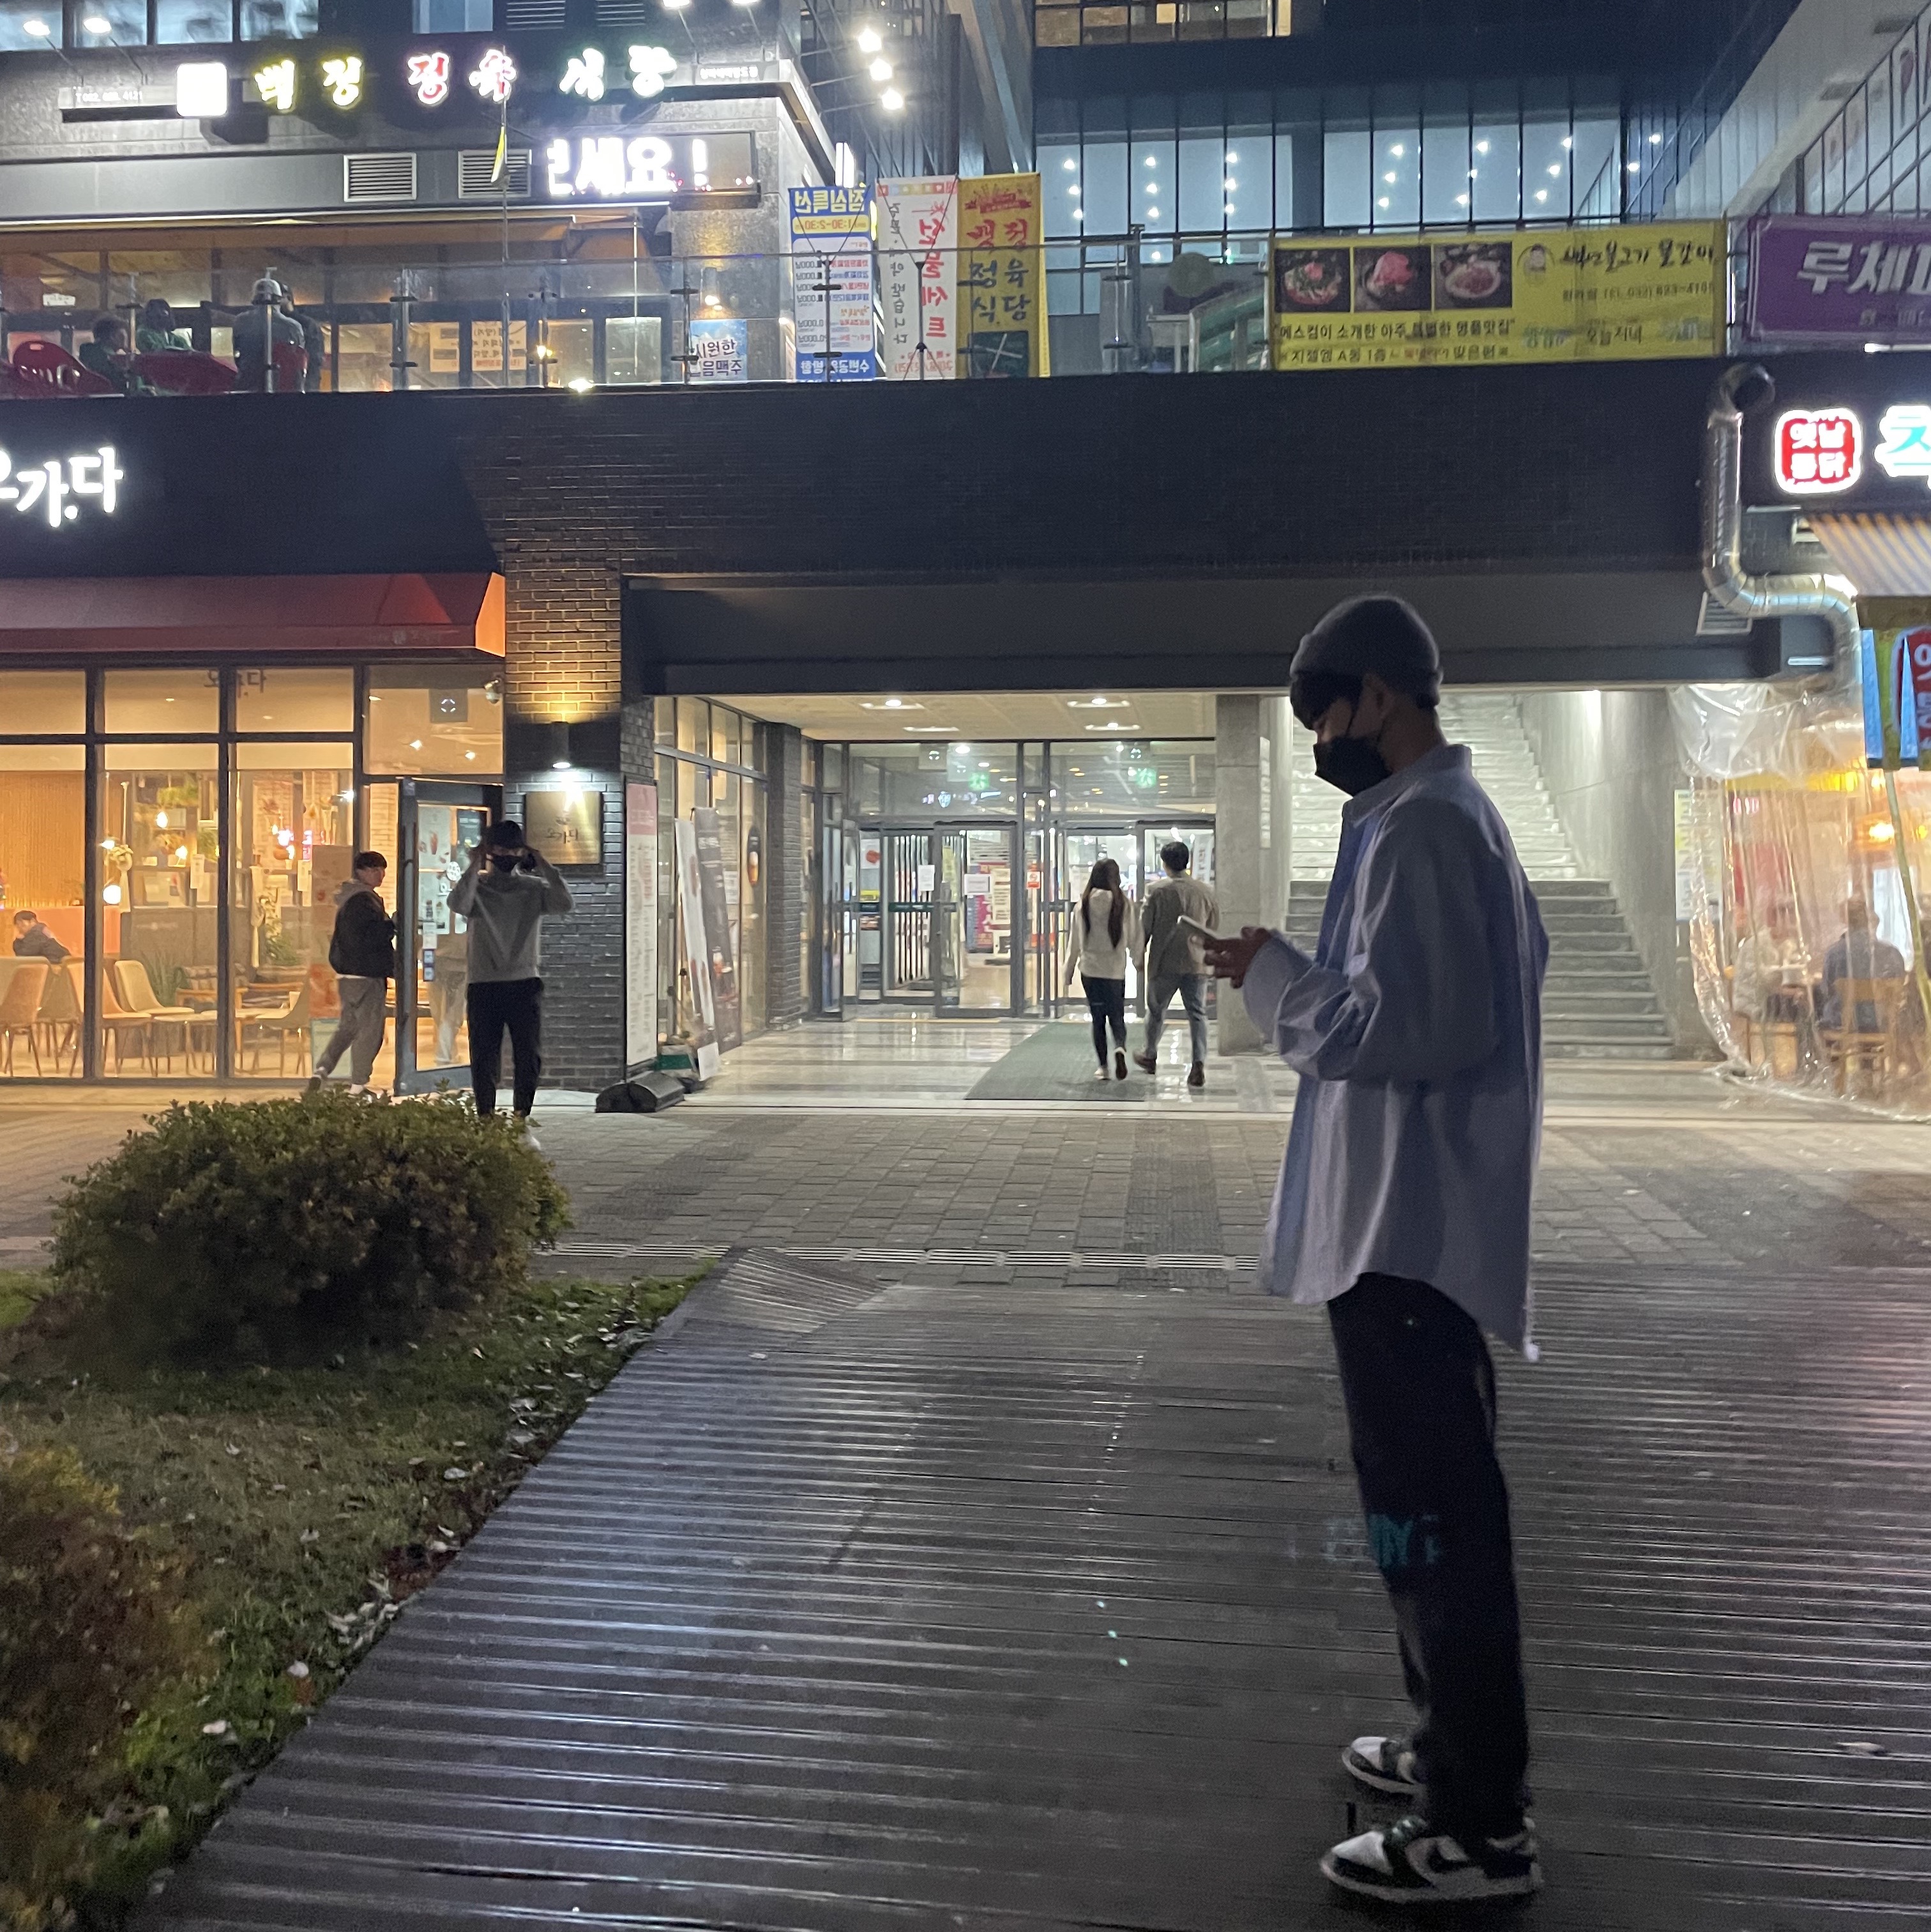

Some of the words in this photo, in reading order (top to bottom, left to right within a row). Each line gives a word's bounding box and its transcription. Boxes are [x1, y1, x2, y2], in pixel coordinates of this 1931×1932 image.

[969, 258, 1029, 287] 정육
[971, 294, 1031, 324] 식당
[1381, 322, 1407, 339] 아주
[695, 338, 737, 358] 시원한
